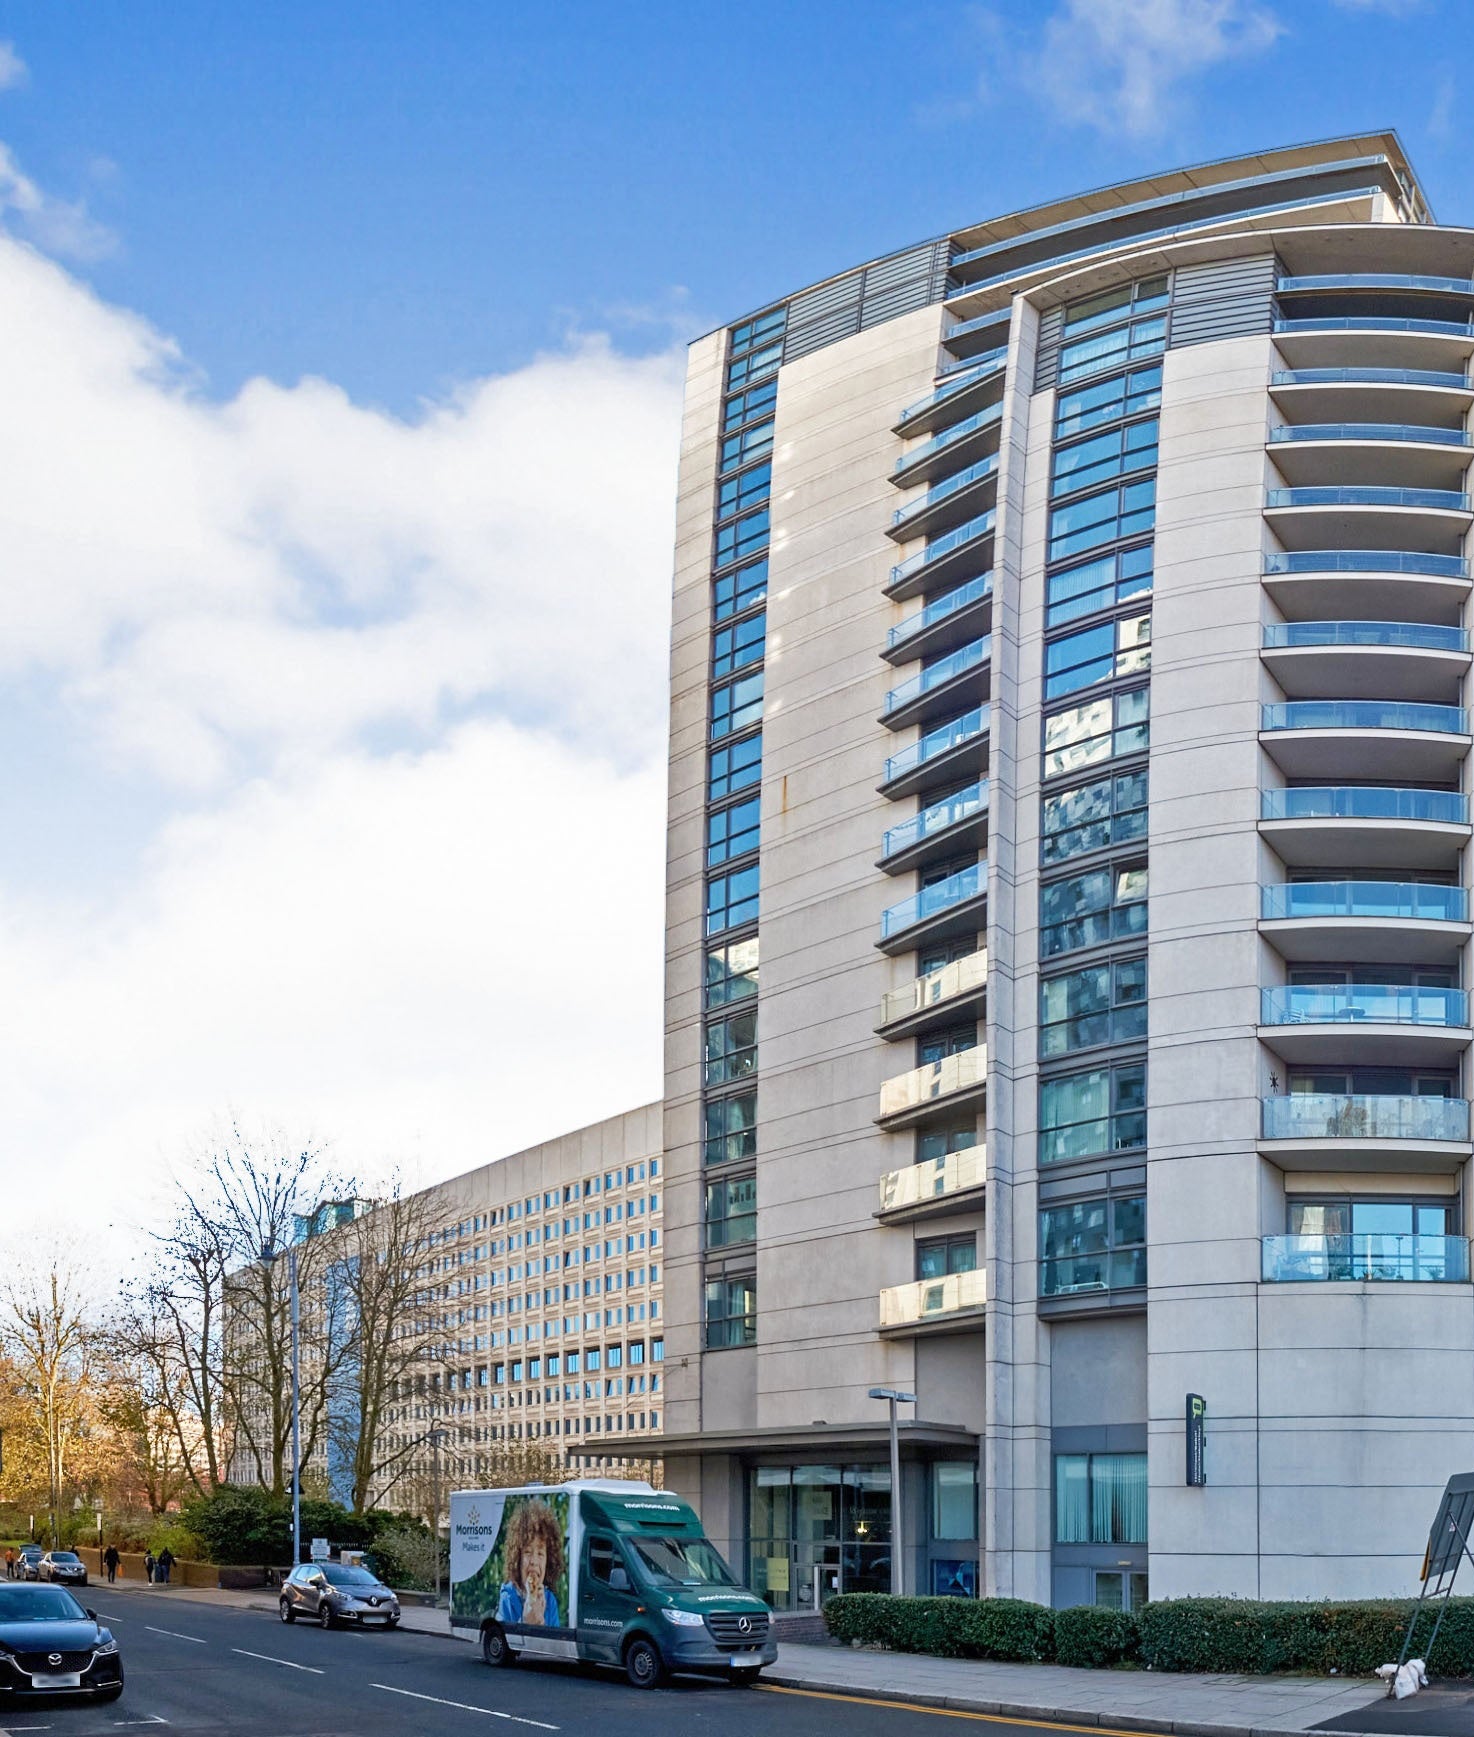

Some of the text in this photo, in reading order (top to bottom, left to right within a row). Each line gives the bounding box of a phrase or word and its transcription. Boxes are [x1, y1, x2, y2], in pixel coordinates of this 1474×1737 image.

[624, 1503, 680, 1511] morrisons.com
[456, 1523, 492, 1535] Morrisons
[462, 1542, 480, 1551] Makes
[583, 1617, 624, 1628] morrisons.com
